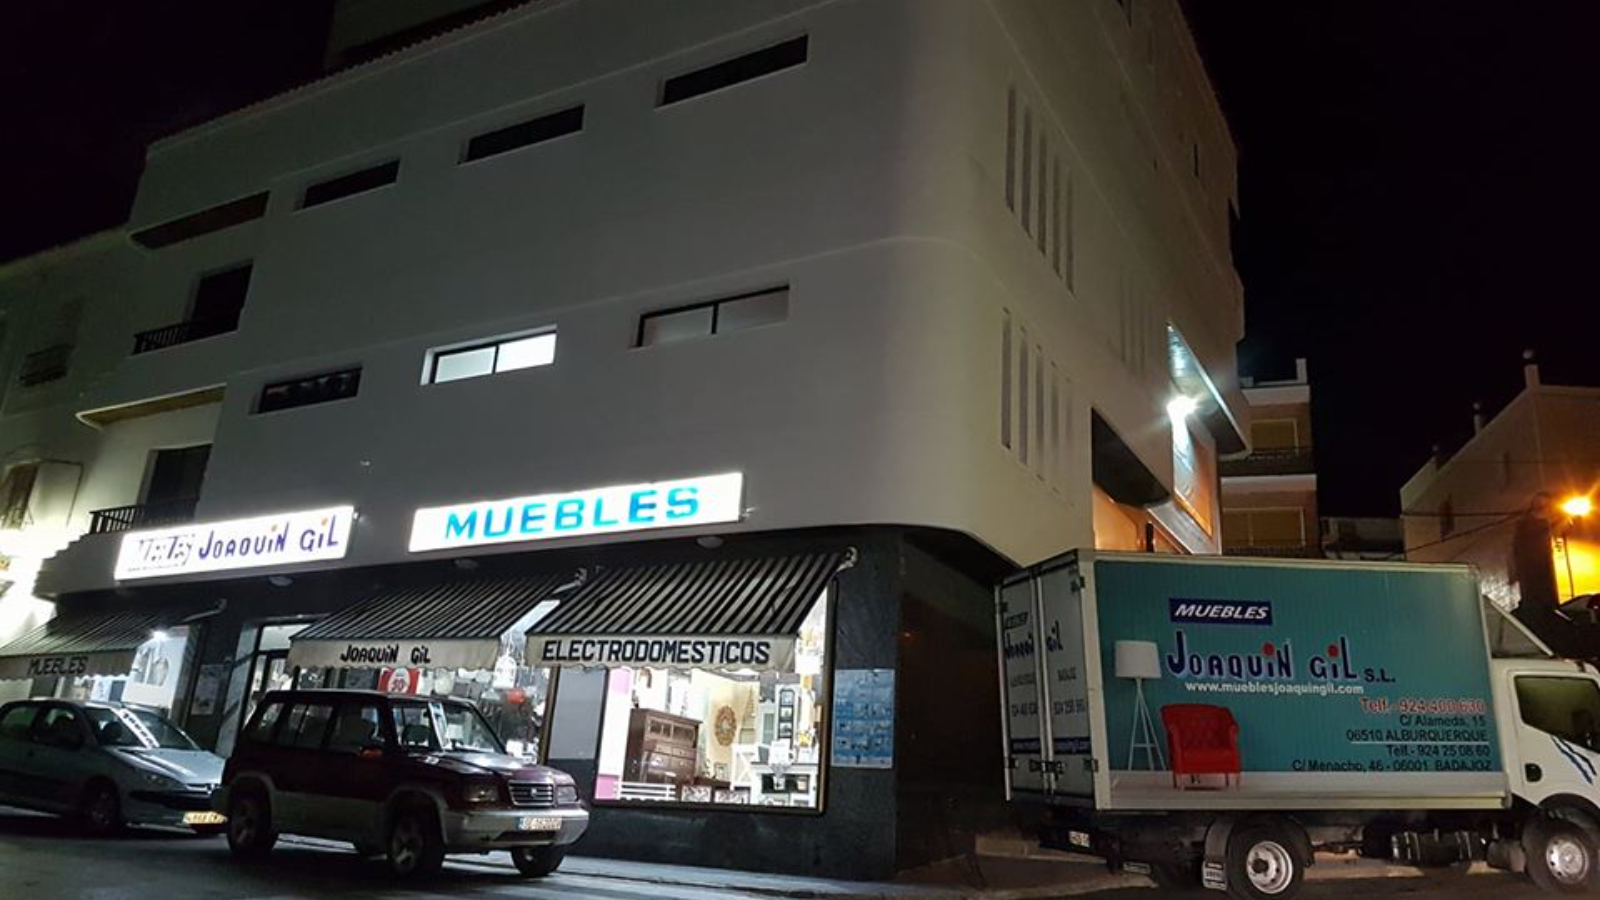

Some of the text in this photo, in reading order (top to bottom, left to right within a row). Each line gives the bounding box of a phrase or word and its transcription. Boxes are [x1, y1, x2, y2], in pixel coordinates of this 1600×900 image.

[445, 487, 699, 539] MUEBLES
[1174, 604, 1269, 619] MUEBLES
[541, 639, 771, 664] ELECTRODOMESTICOS
[1364, 667, 1397, 683] S.L.
[1185, 680, 1364, 697] www.mueblesjoaquingil.com
[1399, 698, 1426, 714] 924
[1400, 715, 1412, 727] C/
[1471, 715, 1486, 727] 15
[1346, 729, 1488, 742] 06510 ALBURQUERQUE
[1417, 745, 1441, 757] 924
[1443, 745, 1458, 757] 25
[1292, 760, 1305, 772] C/
[1307, 760, 1367, 773] Menacho,
[1369, 760, 1384, 771] 46
[1393, 760, 1428, 772] 06001
[1434, 760, 1492, 772] BADAJOZ
